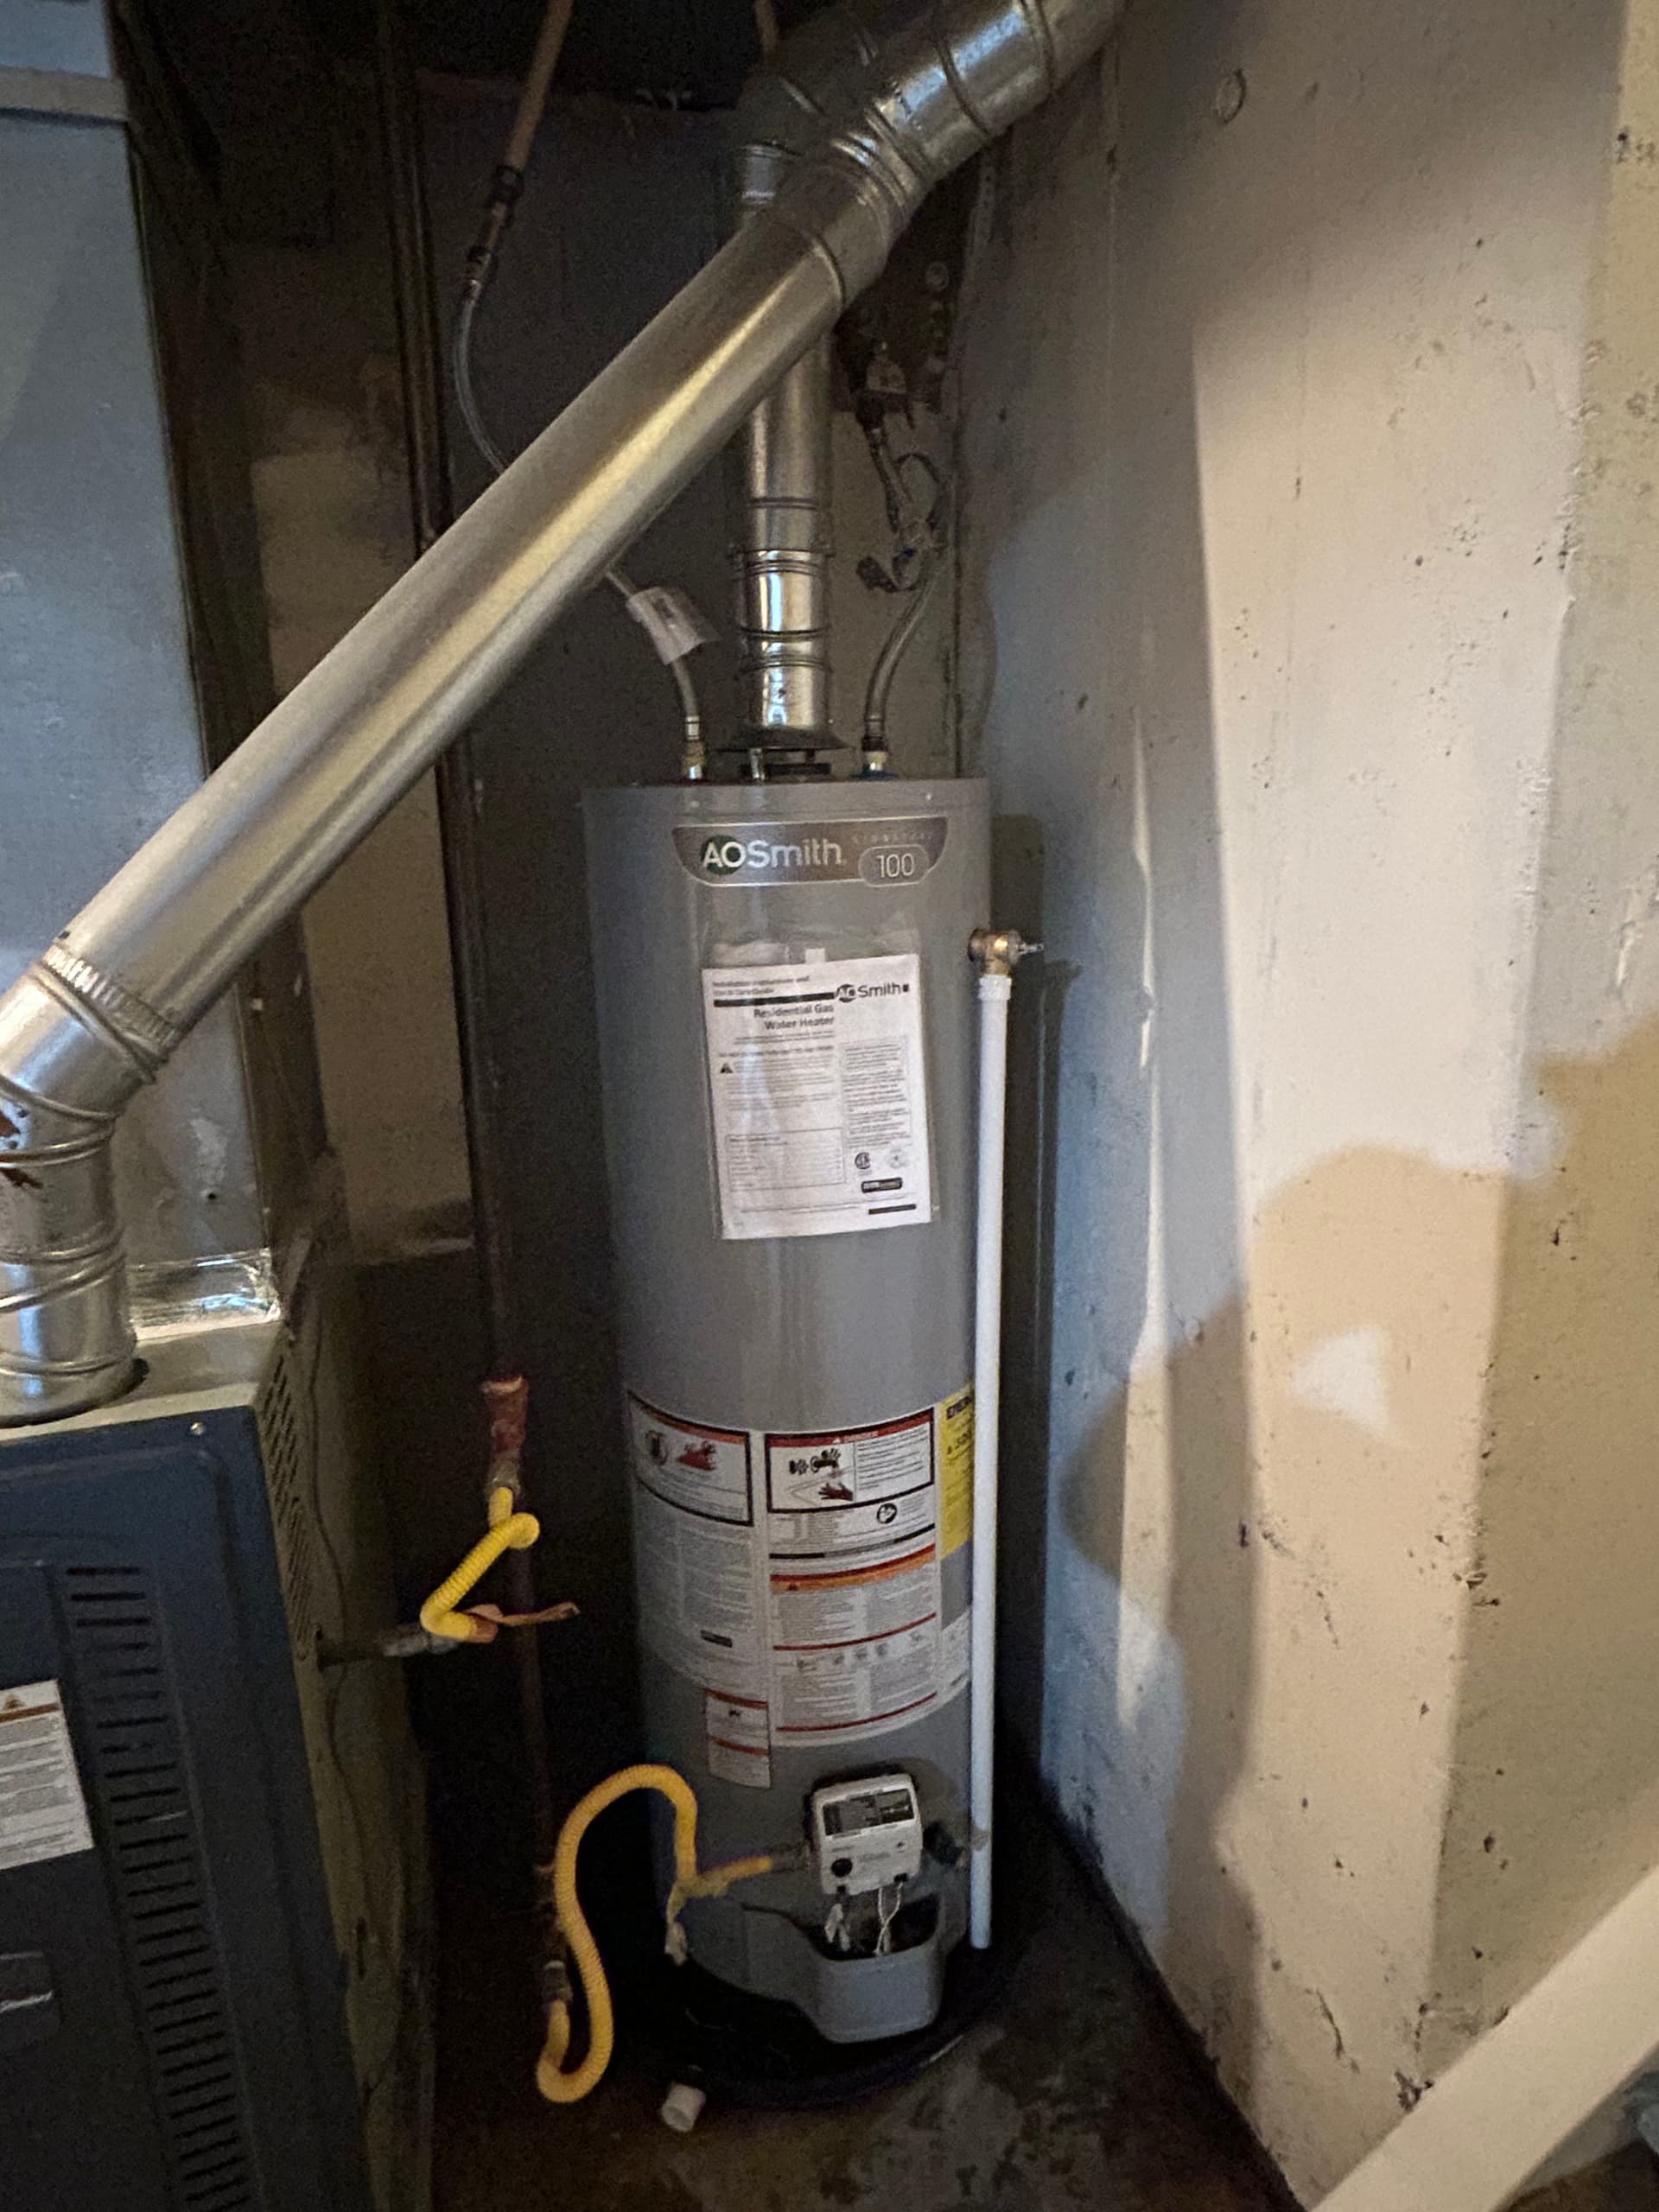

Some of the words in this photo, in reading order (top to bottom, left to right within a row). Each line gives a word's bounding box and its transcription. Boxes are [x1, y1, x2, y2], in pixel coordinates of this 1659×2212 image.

[876, 853, 914, 878] 100
[815, 1003, 835, 1014] Gas
[764, 1020, 797, 1030] Water
[799, 1017, 835, 1027] Heater
